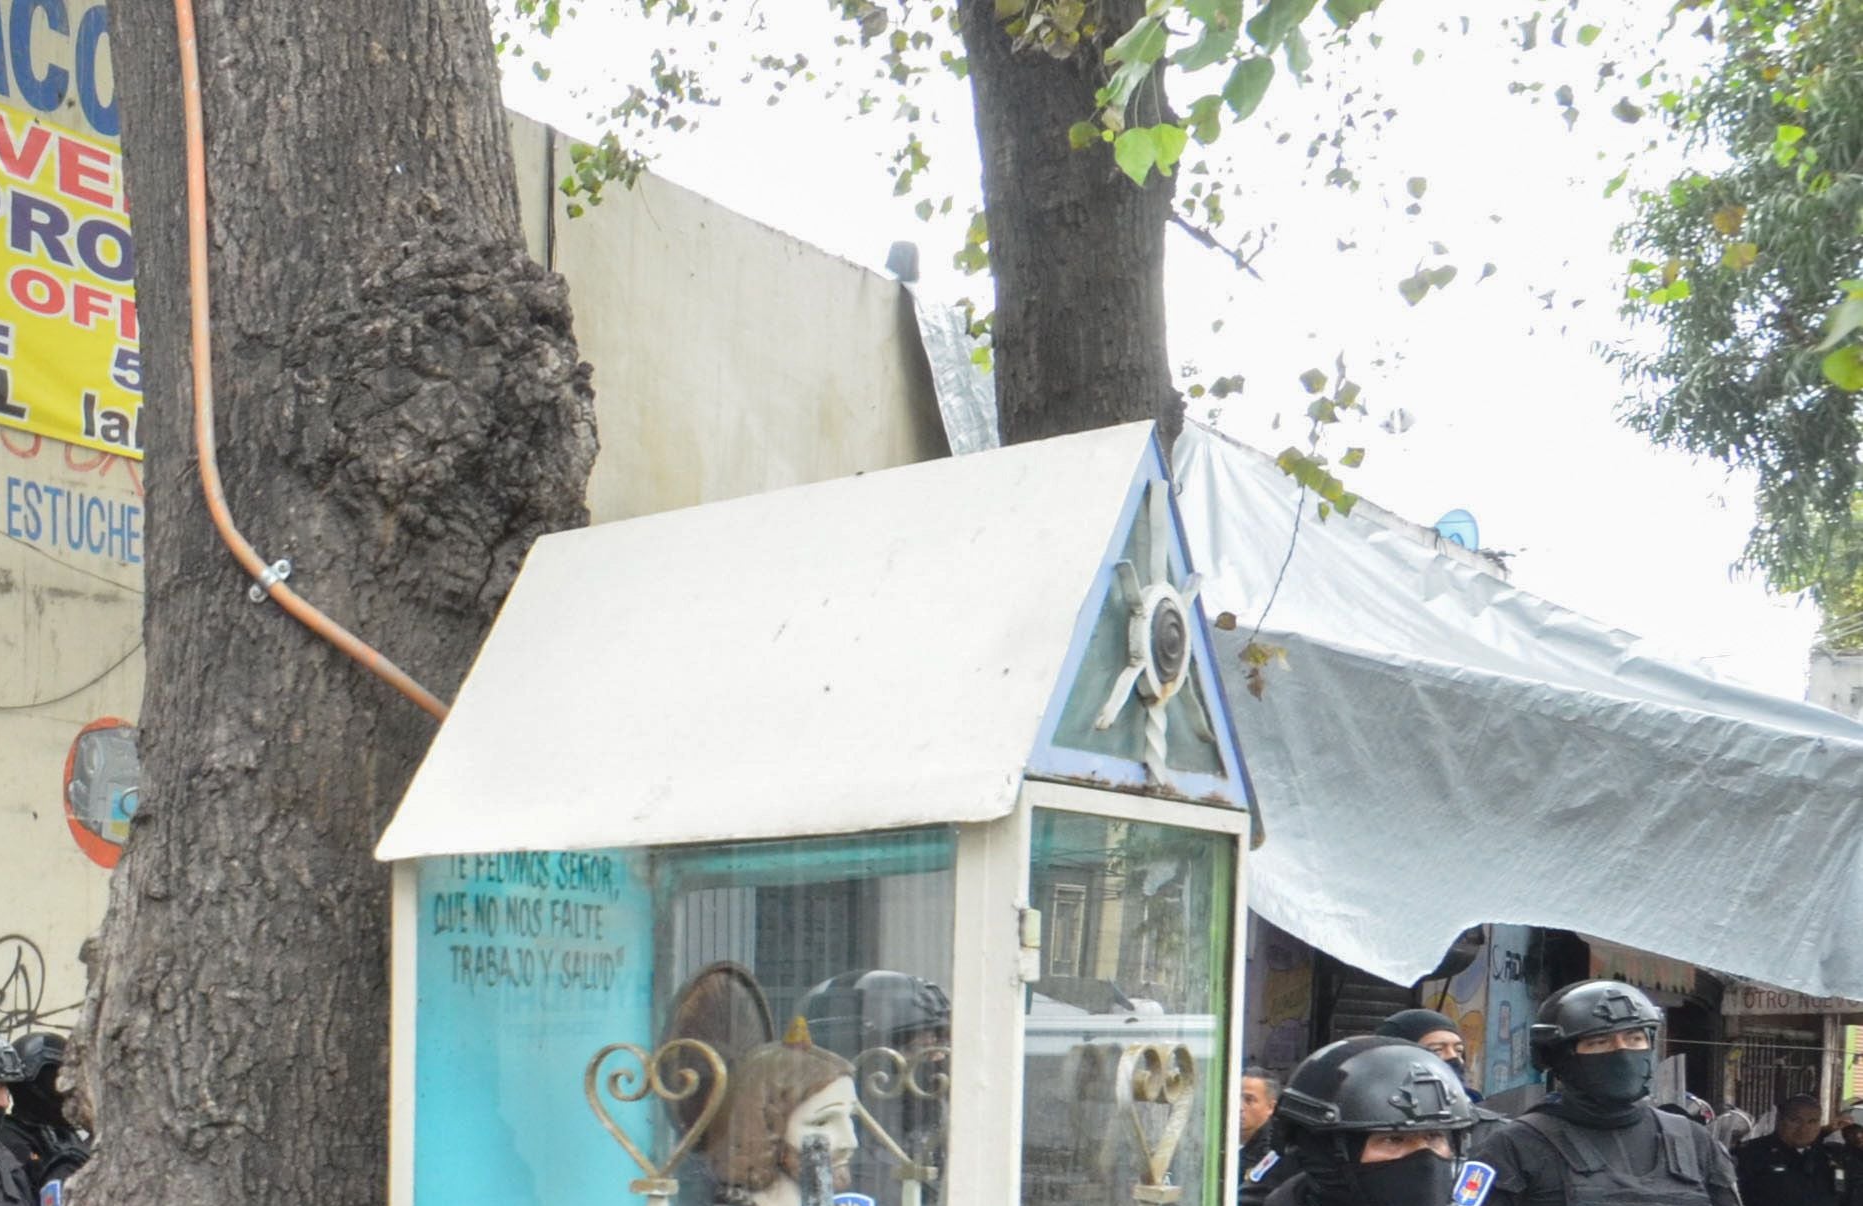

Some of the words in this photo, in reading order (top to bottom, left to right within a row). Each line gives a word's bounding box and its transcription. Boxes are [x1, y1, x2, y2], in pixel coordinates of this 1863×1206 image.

[474, 893, 498, 937] NO
[506, 896, 542, 938] NOS
[549, 899, 604, 941] FALTE
[449, 944, 535, 993] TRABAJO
[542, 948, 553, 988] Y
